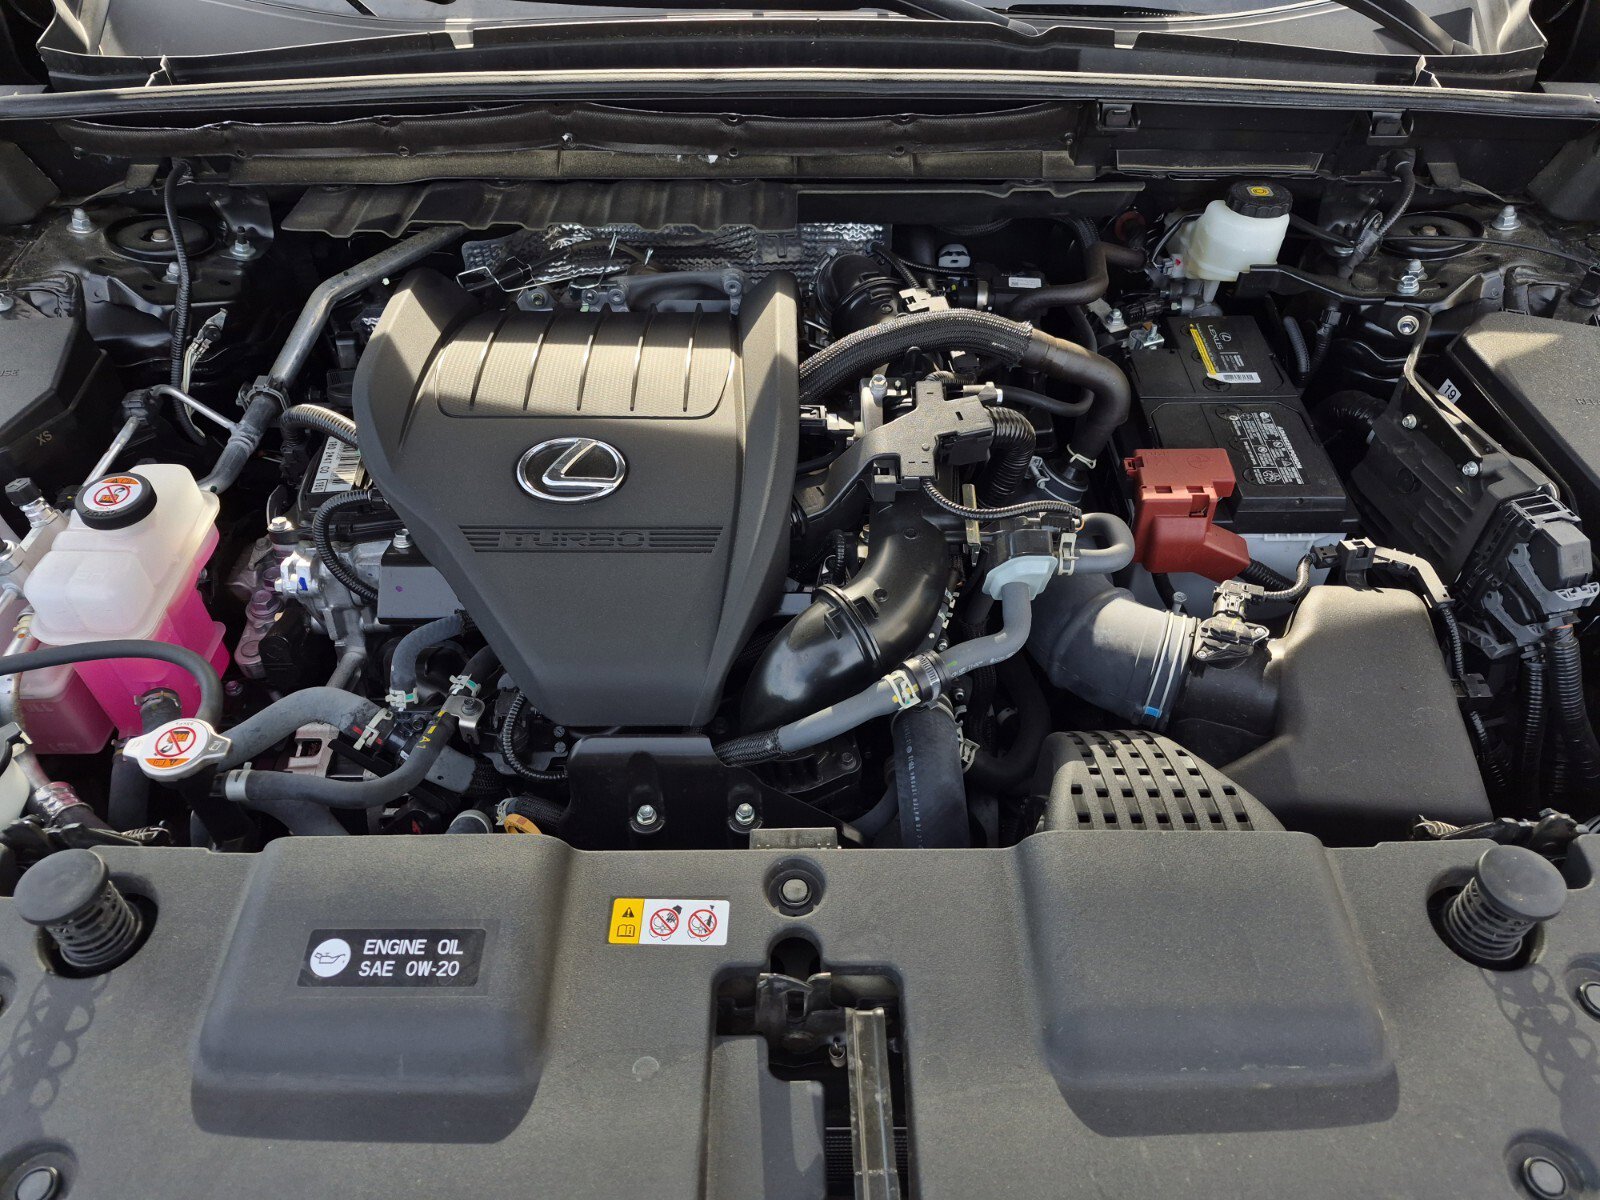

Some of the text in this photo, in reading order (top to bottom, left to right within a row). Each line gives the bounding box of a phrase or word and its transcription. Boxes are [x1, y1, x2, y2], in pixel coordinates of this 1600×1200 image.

[1208, 325, 1223, 349] LEXUS
[1444, 384, 1456, 400] 19
[504, 531, 645, 547] TURBO
[363, 939, 464, 955] ENGINE OIL
[358, 961, 460, 977] SAE 0W-20
